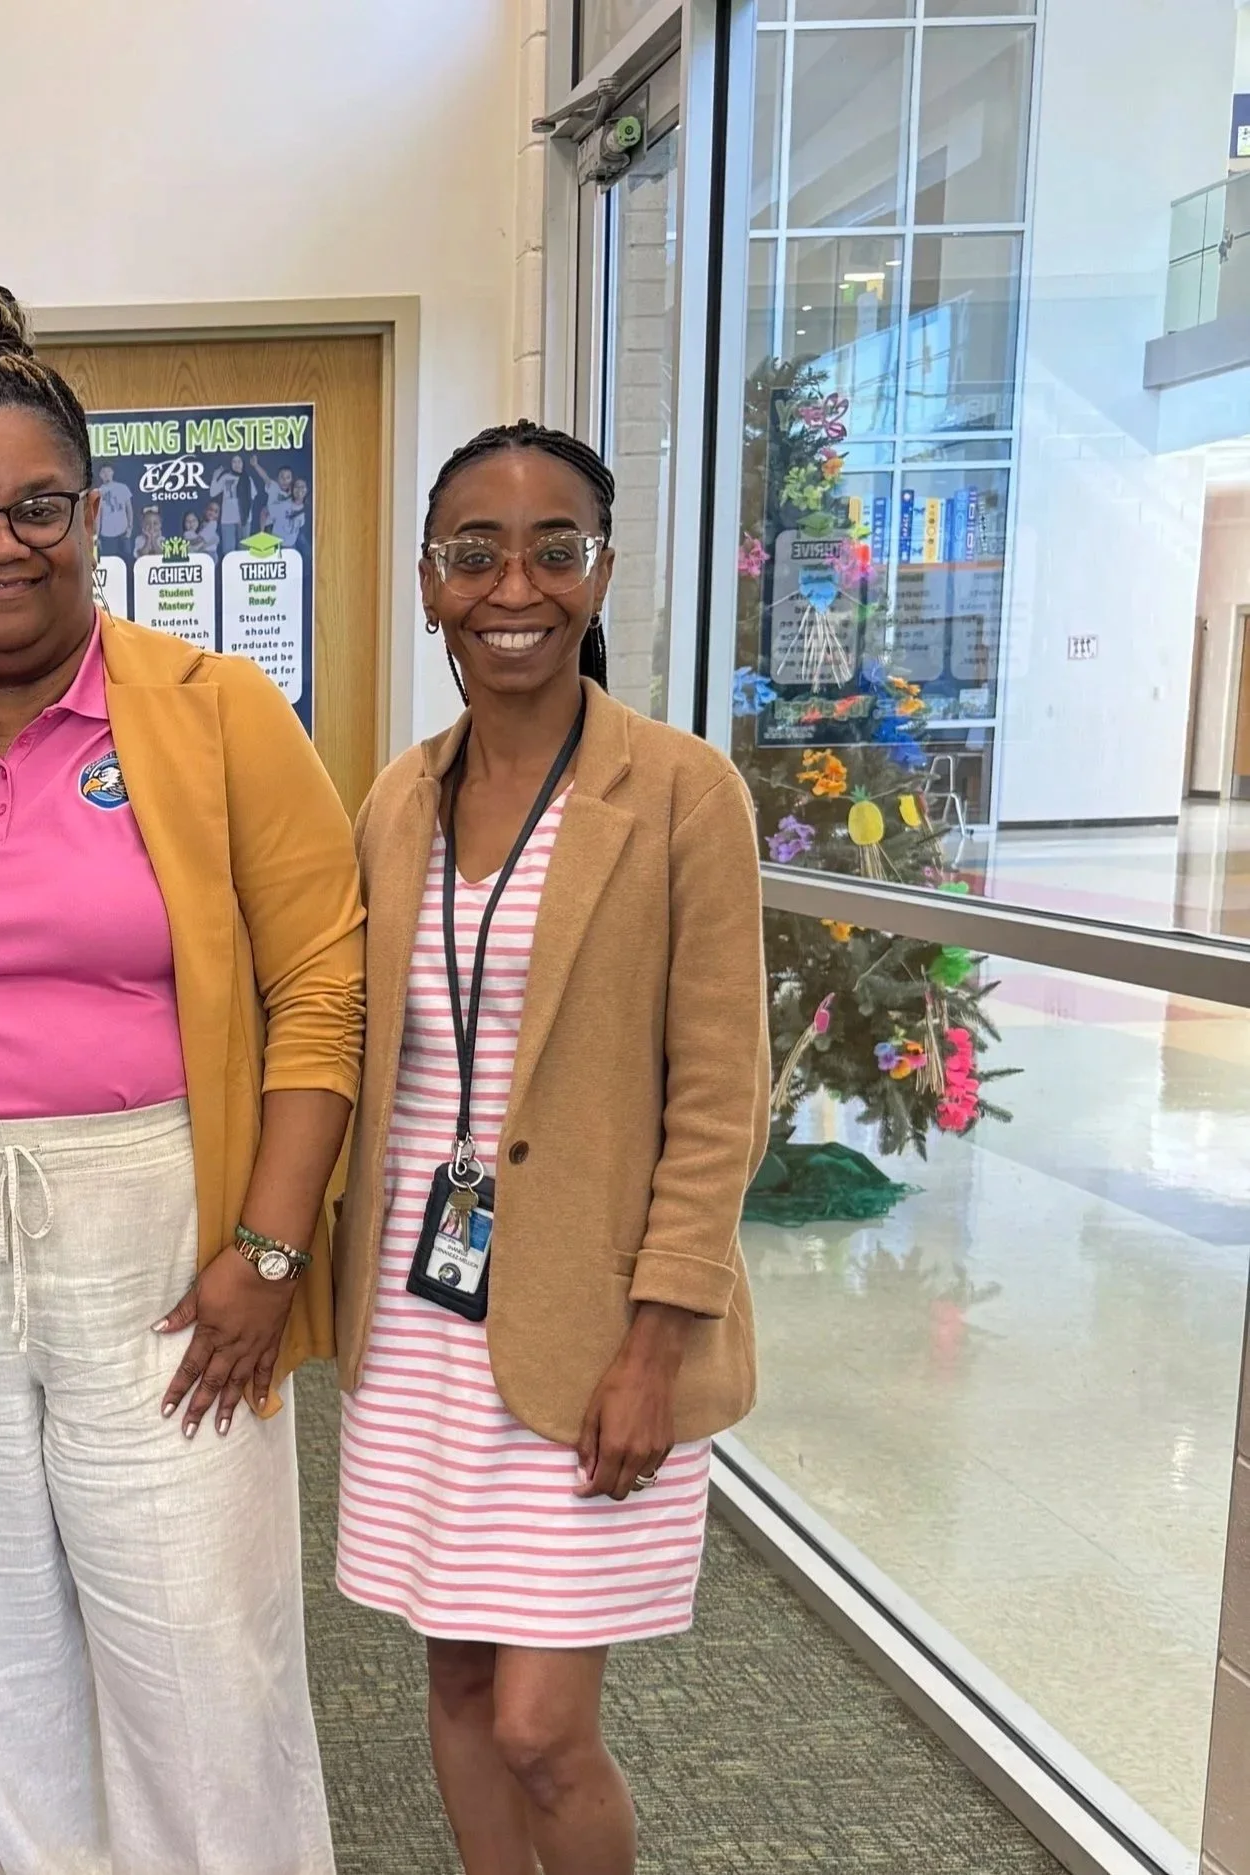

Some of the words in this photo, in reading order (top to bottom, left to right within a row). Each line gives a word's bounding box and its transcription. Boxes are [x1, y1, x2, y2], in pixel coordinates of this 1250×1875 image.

[186, 416, 308, 453] MASTERY
[139, 454, 210, 493] EBR
[152, 491, 198, 501] SCHOOLS
[148, 565, 202, 585] ACHIEVE
[240, 561, 286, 581] THRIVE
[158, 588, 194, 598] Student
[248, 584, 276, 593] Future
[158, 601, 194, 611] Mastery
[248, 596, 277, 606] Ready
[151, 618, 199, 627] Students
[239, 614, 287, 623] Students
[180, 630, 209, 639] reach
[245, 627, 280, 636] should
[231, 640, 278, 651] graduate
[281, 640, 294, 648] on
[258, 653, 278, 662] and
[280, 652, 293, 660] be
[265, 667, 278, 675] ed
[280, 666, 295, 675] for
